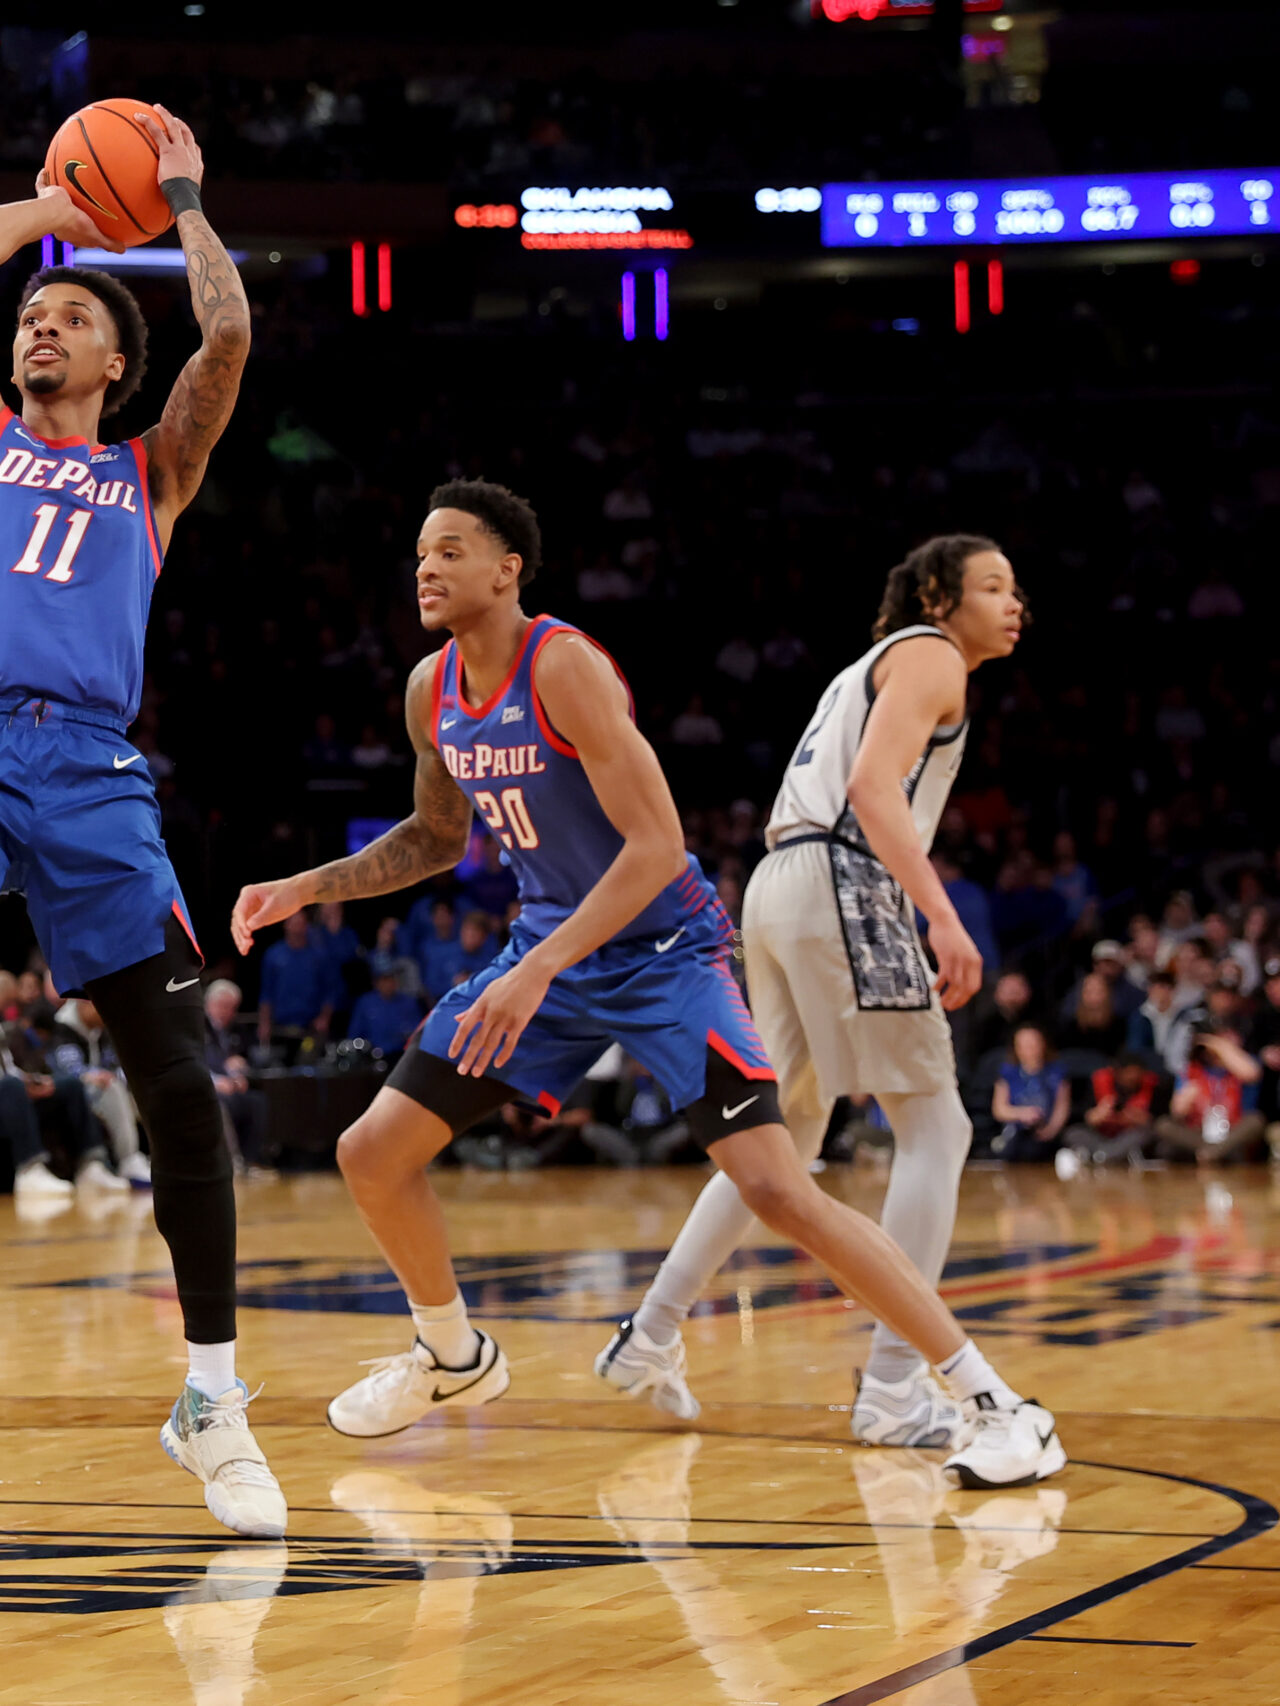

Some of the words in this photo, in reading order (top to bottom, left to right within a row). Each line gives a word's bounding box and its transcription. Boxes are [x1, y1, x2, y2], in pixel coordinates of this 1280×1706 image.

[11, 503, 94, 583] 11
[795, 685, 841, 766] 2
[474, 786, 539, 850] 20
